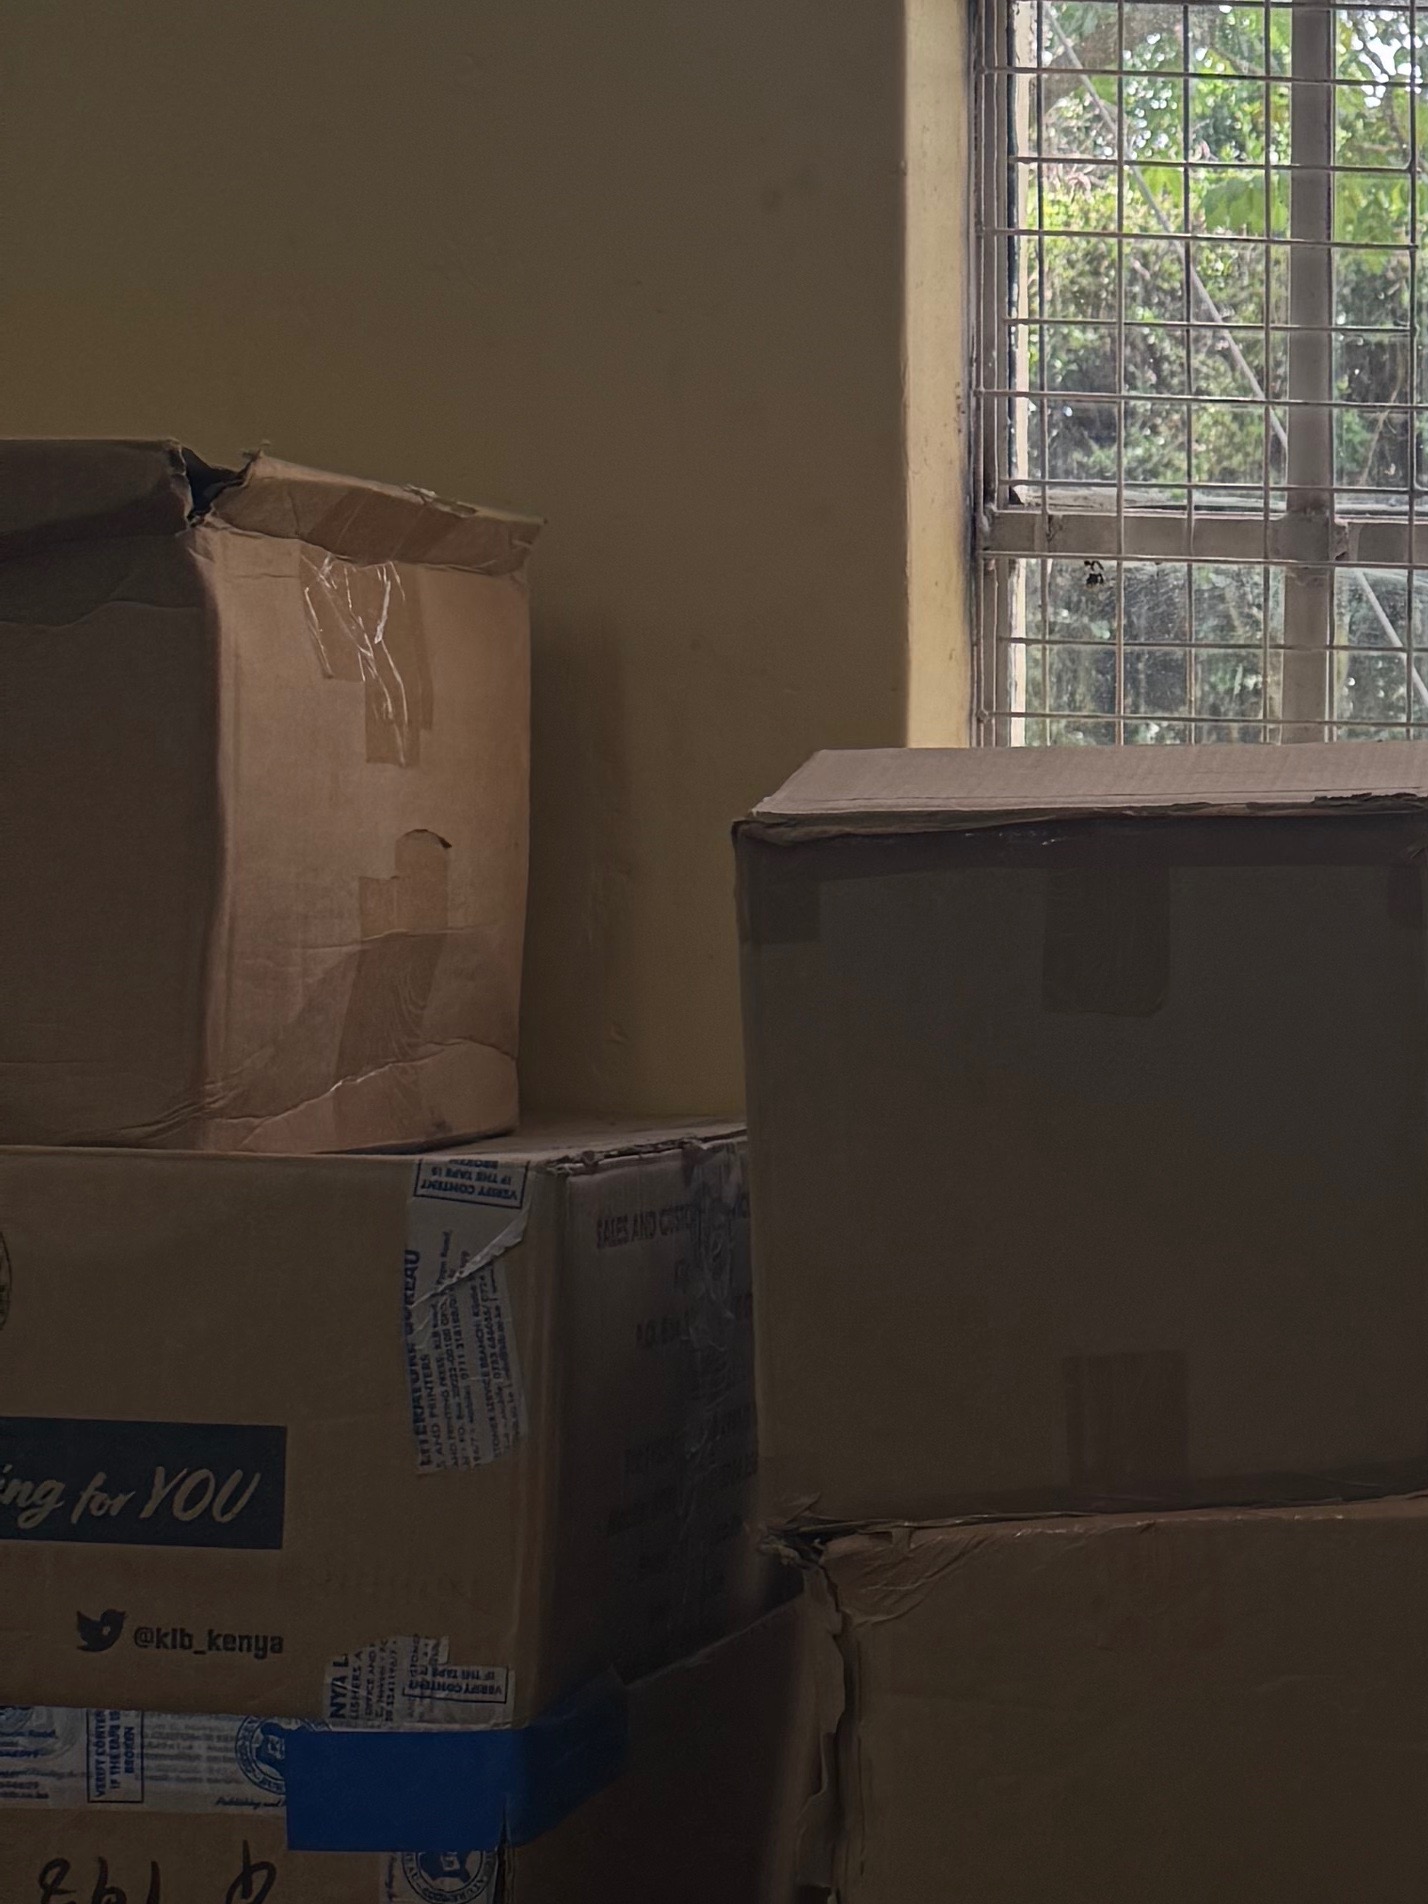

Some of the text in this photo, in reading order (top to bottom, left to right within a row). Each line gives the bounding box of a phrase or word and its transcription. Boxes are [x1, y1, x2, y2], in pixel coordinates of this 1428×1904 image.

[70, 1471, 136, 1525] for
[139, 1466, 262, 1523] YOU
[134, 1626, 285, 1660] @klb_kenya
